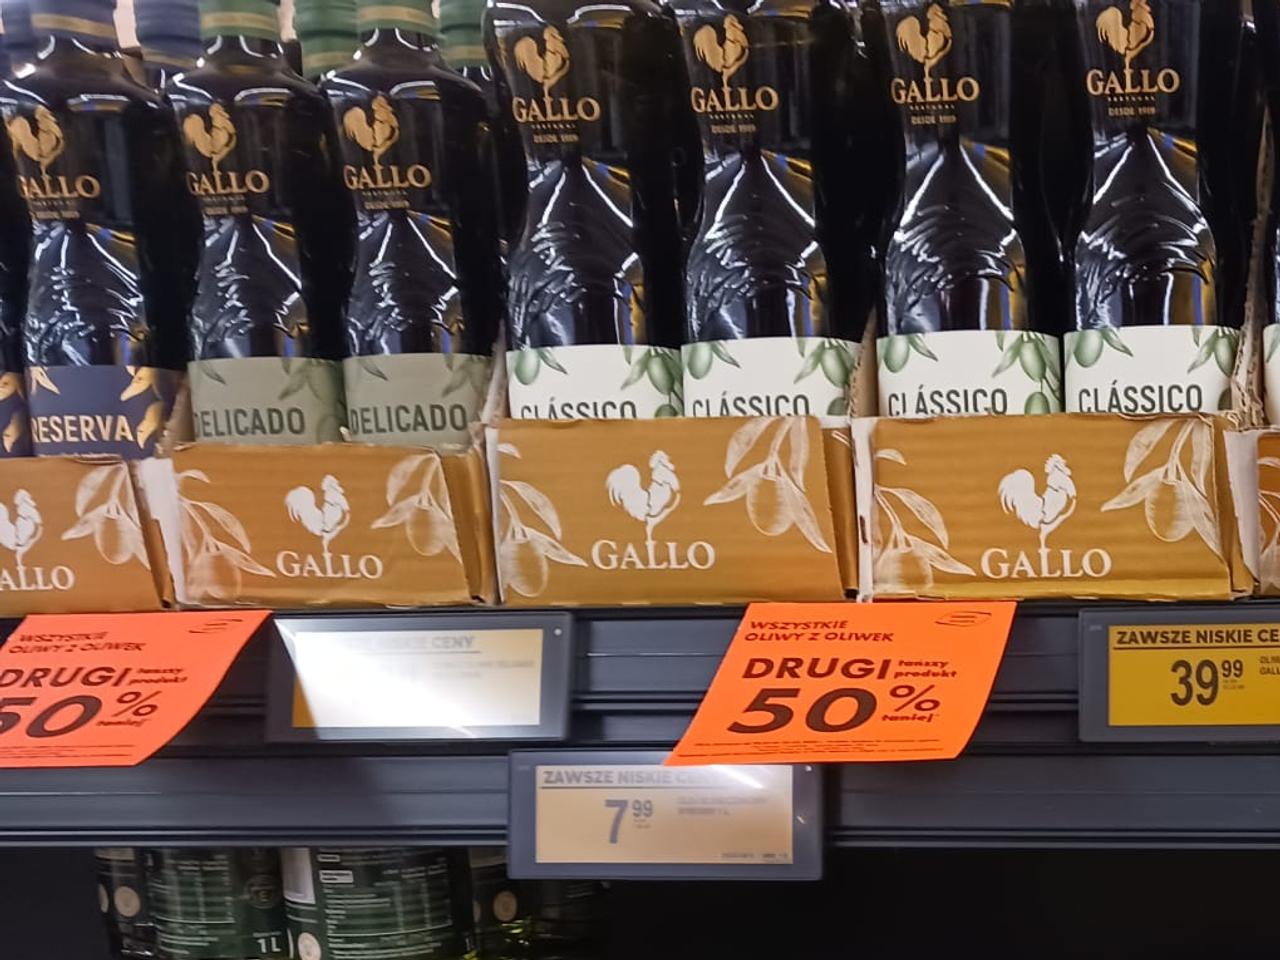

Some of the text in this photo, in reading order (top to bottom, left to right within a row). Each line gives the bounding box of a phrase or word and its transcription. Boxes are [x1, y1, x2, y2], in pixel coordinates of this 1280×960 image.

[890, 76, 980, 104] GALLO
[1086, 68, 1180, 95] GALLO
[512, 96, 600, 123] GALLO
[690, 86, 779, 113] GALLO
[186, 170, 270, 195] GALLO
[343, 164, 432, 190] GALLO
[1078, 379, 1203, 413] CLÁSSICO
[195, 407, 305, 438] ELICADO
[350, 403, 467, 435] DELICADO
[276, 550, 383, 580] GALLO
[591, 540, 715, 570] GALLO
[981, 546, 1112, 579] GALLO
[0, 564, 75, 591] ALLO
[744, 632, 894, 643] OLIWY Z OLIWEK
[750, 620, 848, 631] WSZYSTKIE
[1116, 630, 1191, 645] ZAWSZE
[1196, 629, 1253, 644] NISKIE
[0, 666, 132, 688] DRUGI
[742, 657, 891, 680] DRUGI
[1170, 658, 1244, 707] 39 99
[543, 770, 614, 785] ZAWSZE
[617, 770, 672, 785] NISKIE
[604, 798, 629, 845] 7
[632, 799, 654, 818] 99
